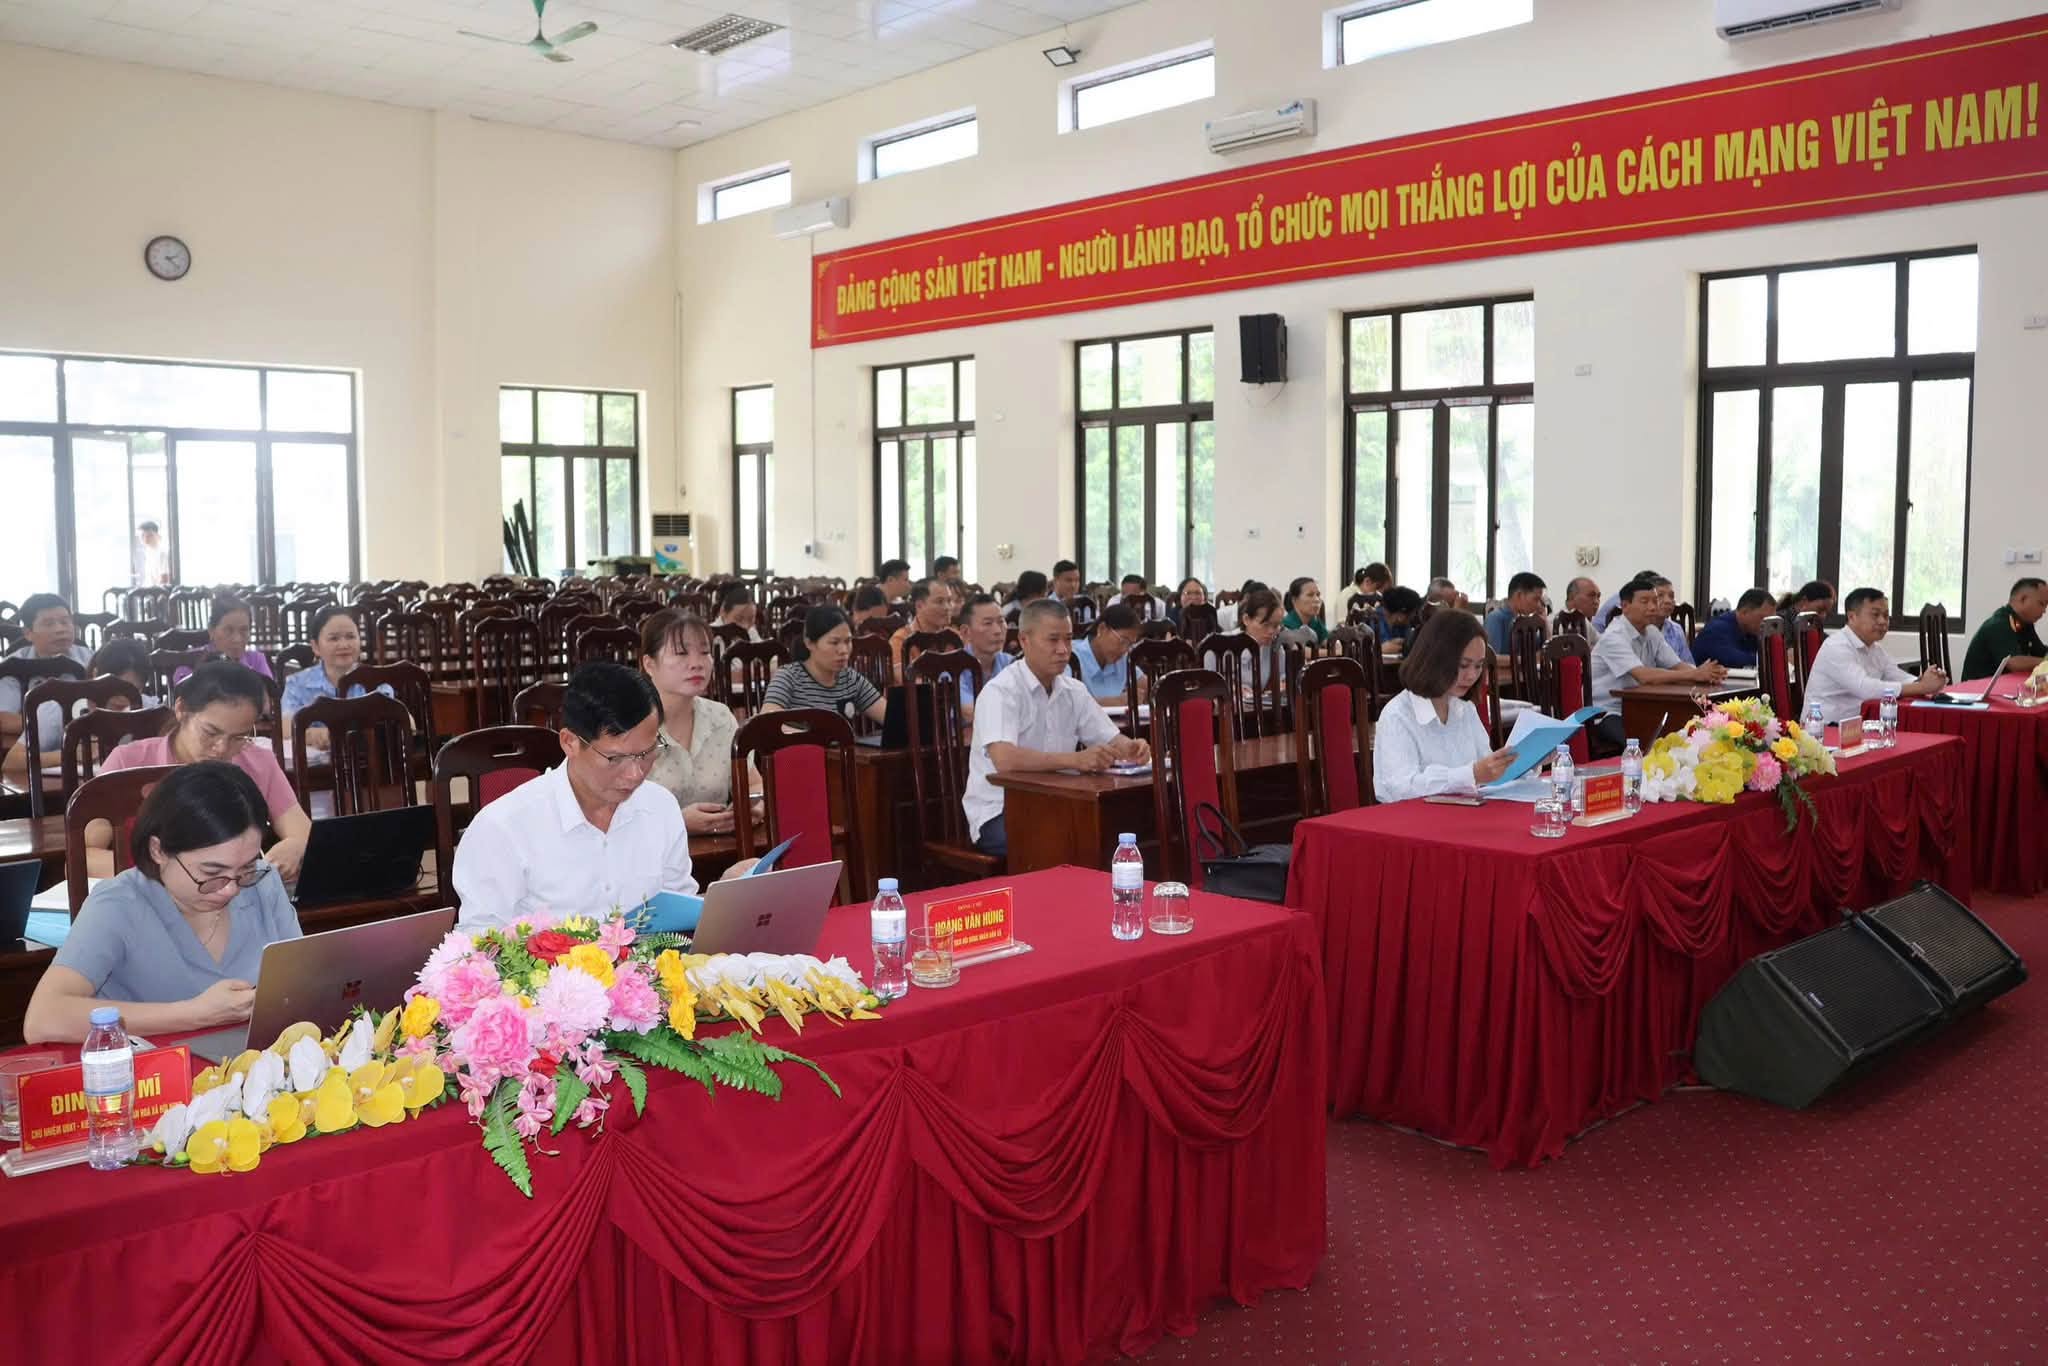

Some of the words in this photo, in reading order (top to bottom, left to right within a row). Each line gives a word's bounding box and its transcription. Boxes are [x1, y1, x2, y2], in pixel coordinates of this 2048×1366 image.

[837, 273, 876, 315] ĐẢNG
[880, 268, 921, 312] CỘNG
[925, 256, 957, 300] SẢN
[962, 252, 997, 299] VIỆT
[1001, 249, 1042, 288] NAM
[1059, 228, 1117, 279] NGƯỜI
[1123, 224, 1175, 269] LÃNH
[1181, 216, 1229, 266] ĐẠO,
[1236, 193, 1264, 250] TỔ
[1270, 192, 1332, 245] CHỨC
[1341, 188, 1388, 240] MỌI
[1396, 162, 1484, 227] THẮNG
[1493, 160, 1537, 220] LỢI
[1546, 141, 1607, 205] CỦA
[1616, 135, 1703, 195] CÁCH
[1714, 119, 1820, 188] MẠNG
[1831, 96, 1913, 171] VIỆT
[1925, 82, 2039, 152] NAM!
[51, 1091, 87, 1115] ĐIN
